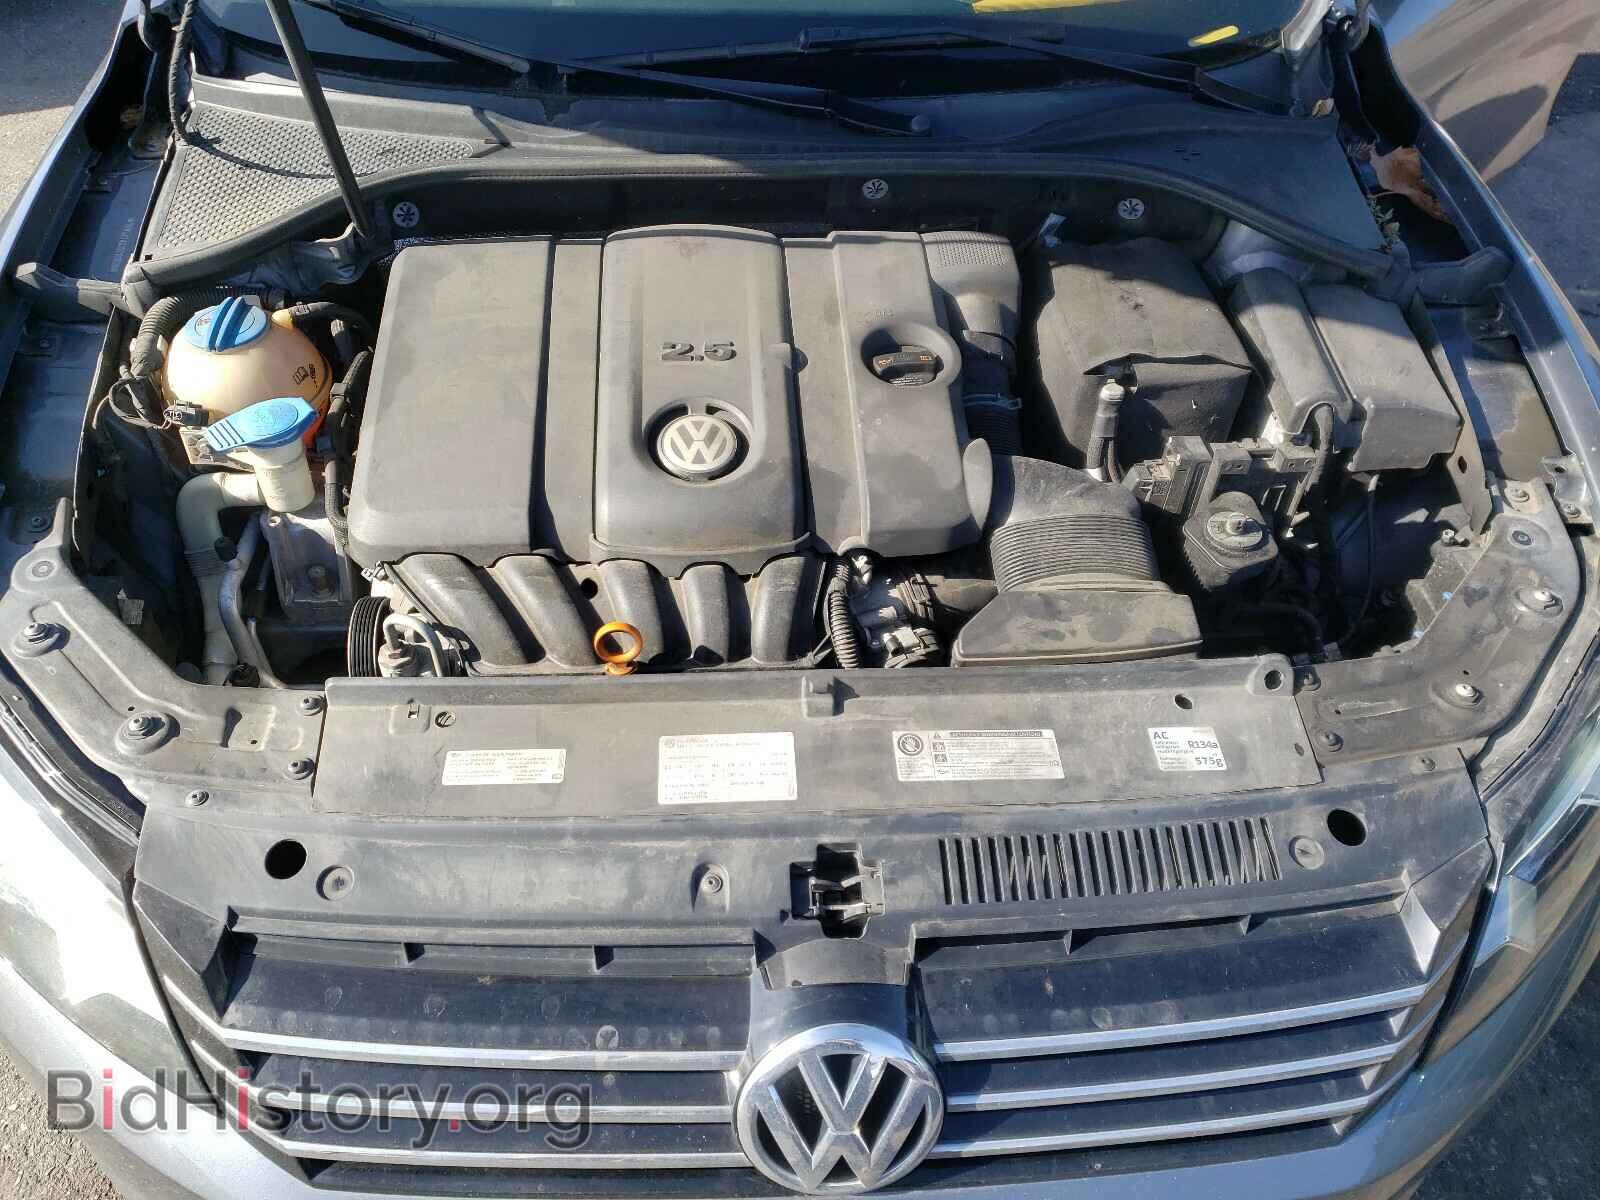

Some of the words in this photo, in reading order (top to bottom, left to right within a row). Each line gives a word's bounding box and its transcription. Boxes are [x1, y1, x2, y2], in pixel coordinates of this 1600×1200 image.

[661, 341, 737, 361] 2.5
[1153, 731, 1168, 740] AC
[1188, 740, 1217, 749] R134a
